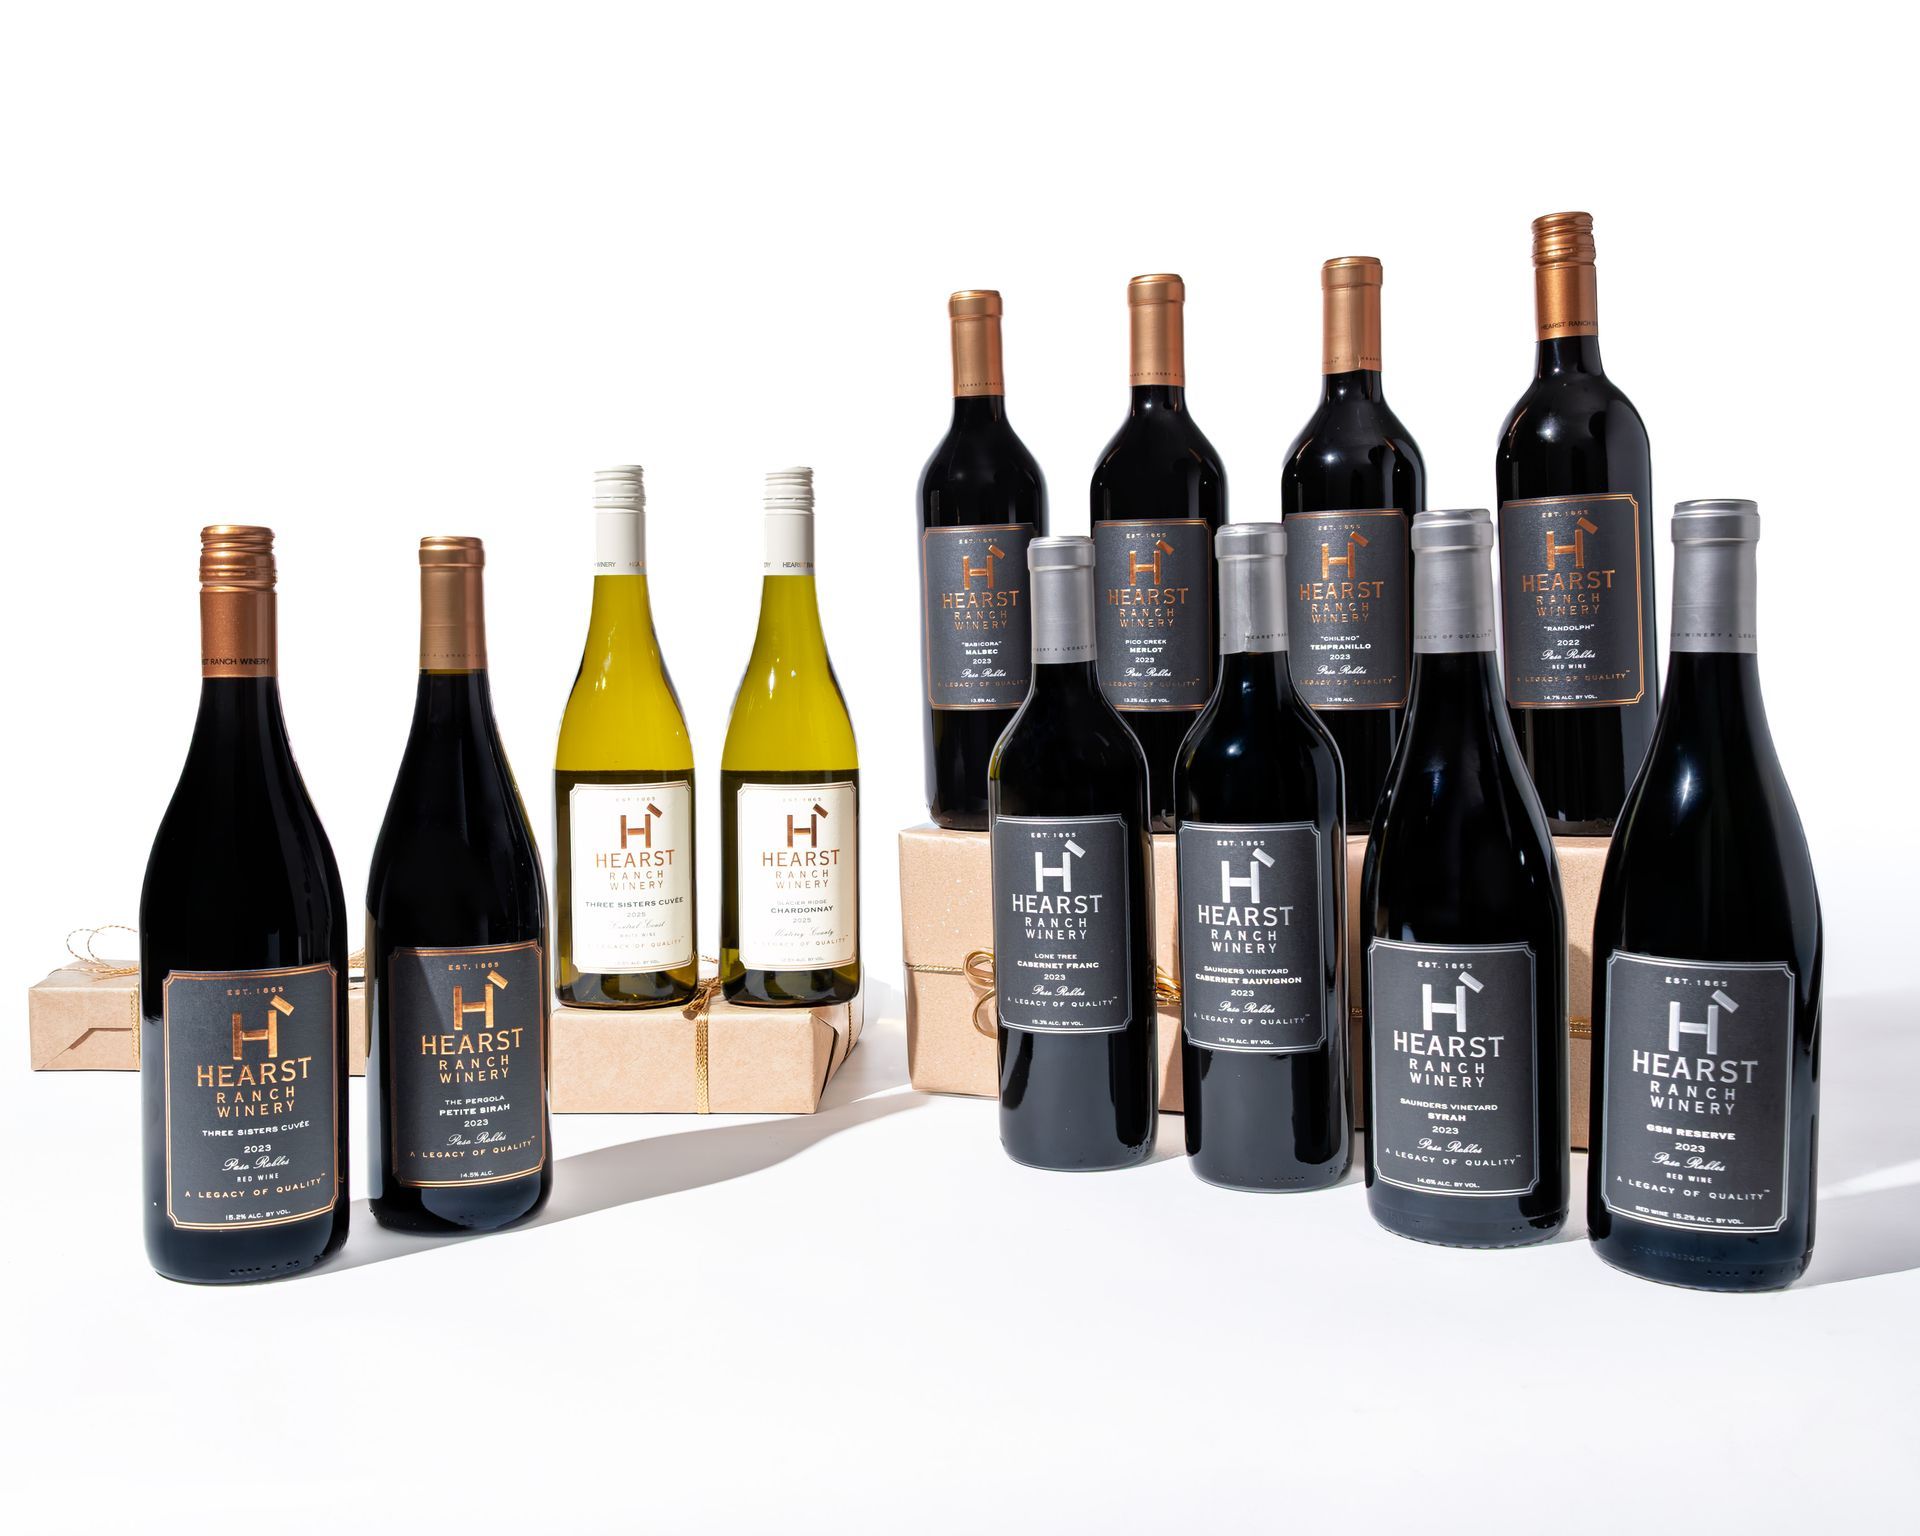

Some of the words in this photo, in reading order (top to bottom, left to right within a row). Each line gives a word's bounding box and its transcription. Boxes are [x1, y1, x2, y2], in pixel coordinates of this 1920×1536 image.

[1541, 321, 1565, 330] HEARST
[1522, 570, 1616, 592] HEARST
[1108, 588, 1188, 605] HEARST
[1300, 581, 1384, 600] HEARST
[942, 590, 1020, 608] HEARST
[1536, 593, 1600, 605] RANCH
[1120, 608, 1174, 618] RANCH
[1311, 602, 1369, 612] RANCH
[1536, 604, 1600, 616] WINERY
[954, 610, 1007, 620] RANCH
[1311, 614, 1369, 623] WINERY
[954, 620, 1007, 630] WINERY
[1120, 618, 1174, 628] WINERY
[1541, 650, 1562, 660] Paso
[1564, 650, 1596, 660] Robles
[960, 669, 978, 678] Paso
[980, 668, 1006, 677] Robles
[1124, 667, 1142, 677] Paso
[1144, 666, 1172, 676] Robles
[1316, 665, 1336, 674] Paso
[1338, 665, 1367, 674] Robles
[596, 849, 675, 868] HEARST
[762, 849, 840, 867] HEARST
[610, 870, 664, 880] RANCH
[775, 870, 828, 878] RANCH
[610, 880, 664, 890] WINERY
[776, 880, 828, 888] WINERY
[618, 900, 656, 908] SISTERS
[770, 905, 834, 914] CHARDONNAY
[1012, 894, 1102, 914] HEARST
[1198, 904, 1294, 926] HEARST
[1024, 916, 1087, 928] RANCH
[1025, 928, 1087, 940] WINERY
[1211, 928, 1276, 940] RANCH
[1212, 942, 1276, 954] WINERY
[1017, 960, 1064, 968] CABERNET
[1204, 966, 1244, 974] SAUNDERS
[1196, 974, 1240, 984] CABERNET
[1666, 976, 1692, 986] EST.
[1032, 984, 1052, 995] Paso
[1054, 986, 1086, 996] Robles
[1218, 1000, 1240, 1012] Paso
[1242, 1002, 1276, 1014] Robles
[421, 1028, 524, 1055] HEARST
[1394, 1030, 1504, 1058] HEARST
[439, 1054, 509, 1070] RANCH
[1410, 1058, 1484, 1074] RANCH
[1632, 1050, 1758, 1084] HEARST
[197, 1056, 312, 1087] HEARST
[439, 1068, 509, 1084] WINERY
[1410, 1072, 1484, 1088] WINERY
[216, 1086, 295, 1103] RANCH
[1650, 1080, 1736, 1100] RANCH
[465, 1096, 505, 1104] PERGOLA
[1400, 1098, 1448, 1110] SAUNDERS
[1650, 1095, 1735, 1116] WINERY
[216, 1101, 295, 1118] WINERY
[440, 1108, 477, 1116] PETITE
[480, 1104, 511, 1114] SIRAH
[464, 1118, 489, 1128] 2023
[1428, 1113, 1466, 1122] SYRAH
[202, 1129, 234, 1137] THREE
[237, 1126, 278, 1136] SISTERS
[281, 1121, 310, 1131] CUVÉE
[1432, 1126, 1459, 1134] 2023
[1646, 1124, 1672, 1134] GSM
[1676, 1128, 1736, 1140] RESERVE
[446, 1134, 471, 1146] Paso
[474, 1132, 507, 1144] Robles
[243, 1144, 272, 1153] 2023
[1417, 1138, 1442, 1152] Paso
[1445, 1140, 1483, 1154] Robles
[1674, 1142, 1706, 1154] 2023
[222, 1158, 249, 1171] Paso
[252, 1156, 290, 1169] Robles
[1396, 1150, 1435, 1163] LEGACY
[1443, 1158, 1457, 1166] OF
[1652, 1151, 1680, 1168] Paso
[1684, 1156, 1726, 1172] Robles
[258, 1173, 279, 1181] WINE
[1666, 1172, 1683, 1181] RED
[1688, 1176, 1712, 1184] WINE
[198, 1190, 245, 1198] LEGACY
[253, 1188, 268, 1196] OF
[1628, 1180, 1676, 1194] LEGACY
[1683, 1190, 1700, 1198] OF
[1635, 1205, 1650, 1214] RED
[1650, 1209, 1669, 1218] WINE
[1697, 1216, 1714, 1224] ALC.
